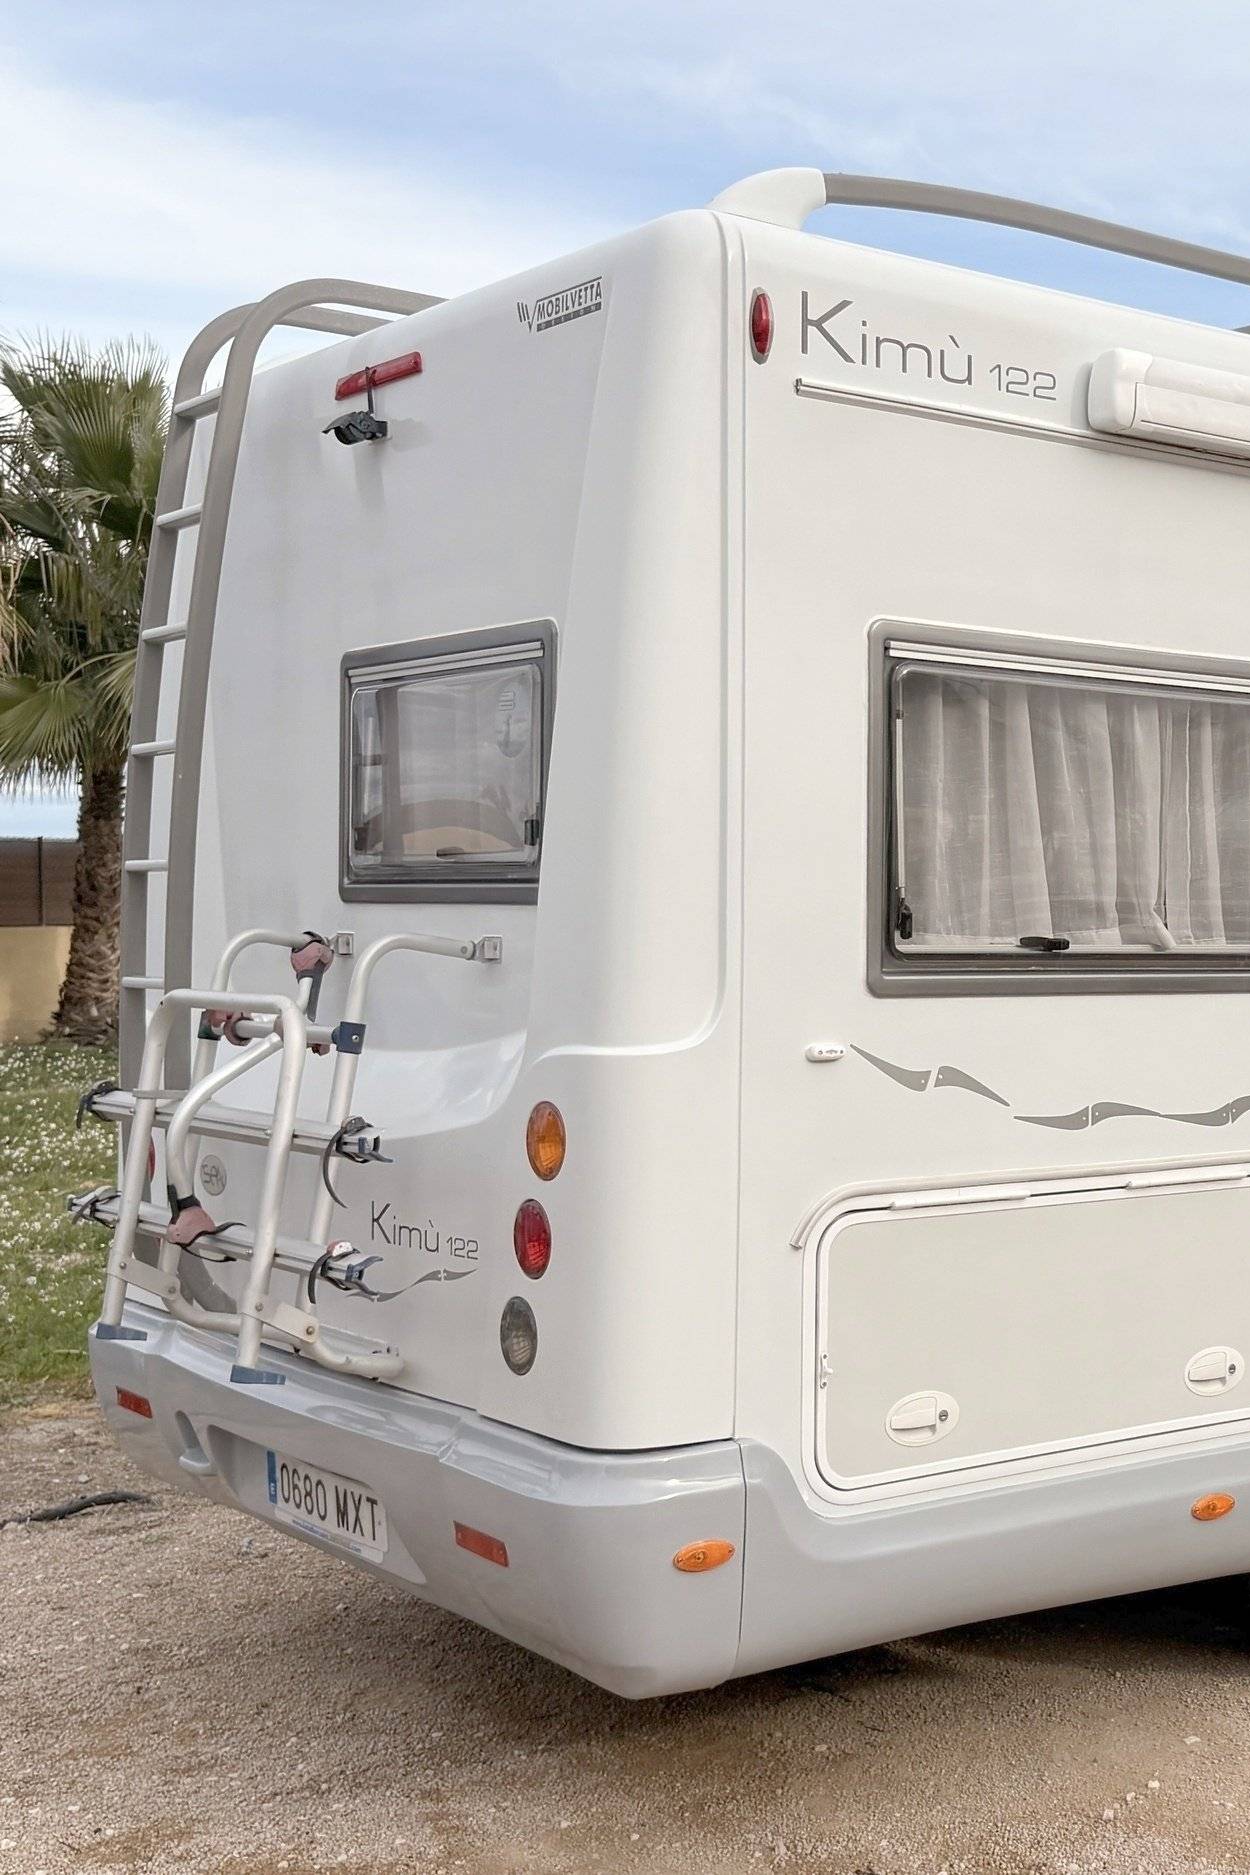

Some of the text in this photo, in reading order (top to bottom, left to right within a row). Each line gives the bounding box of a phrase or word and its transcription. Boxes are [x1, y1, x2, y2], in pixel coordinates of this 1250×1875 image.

[536, 281, 602, 322] MOBILVETTA
[801, 290, 1057, 401] Kimù 122
[371, 1200, 479, 1260] Kimù 122
[280, 1462, 328, 1522] 0680
[335, 1485, 378, 1541] MXT
